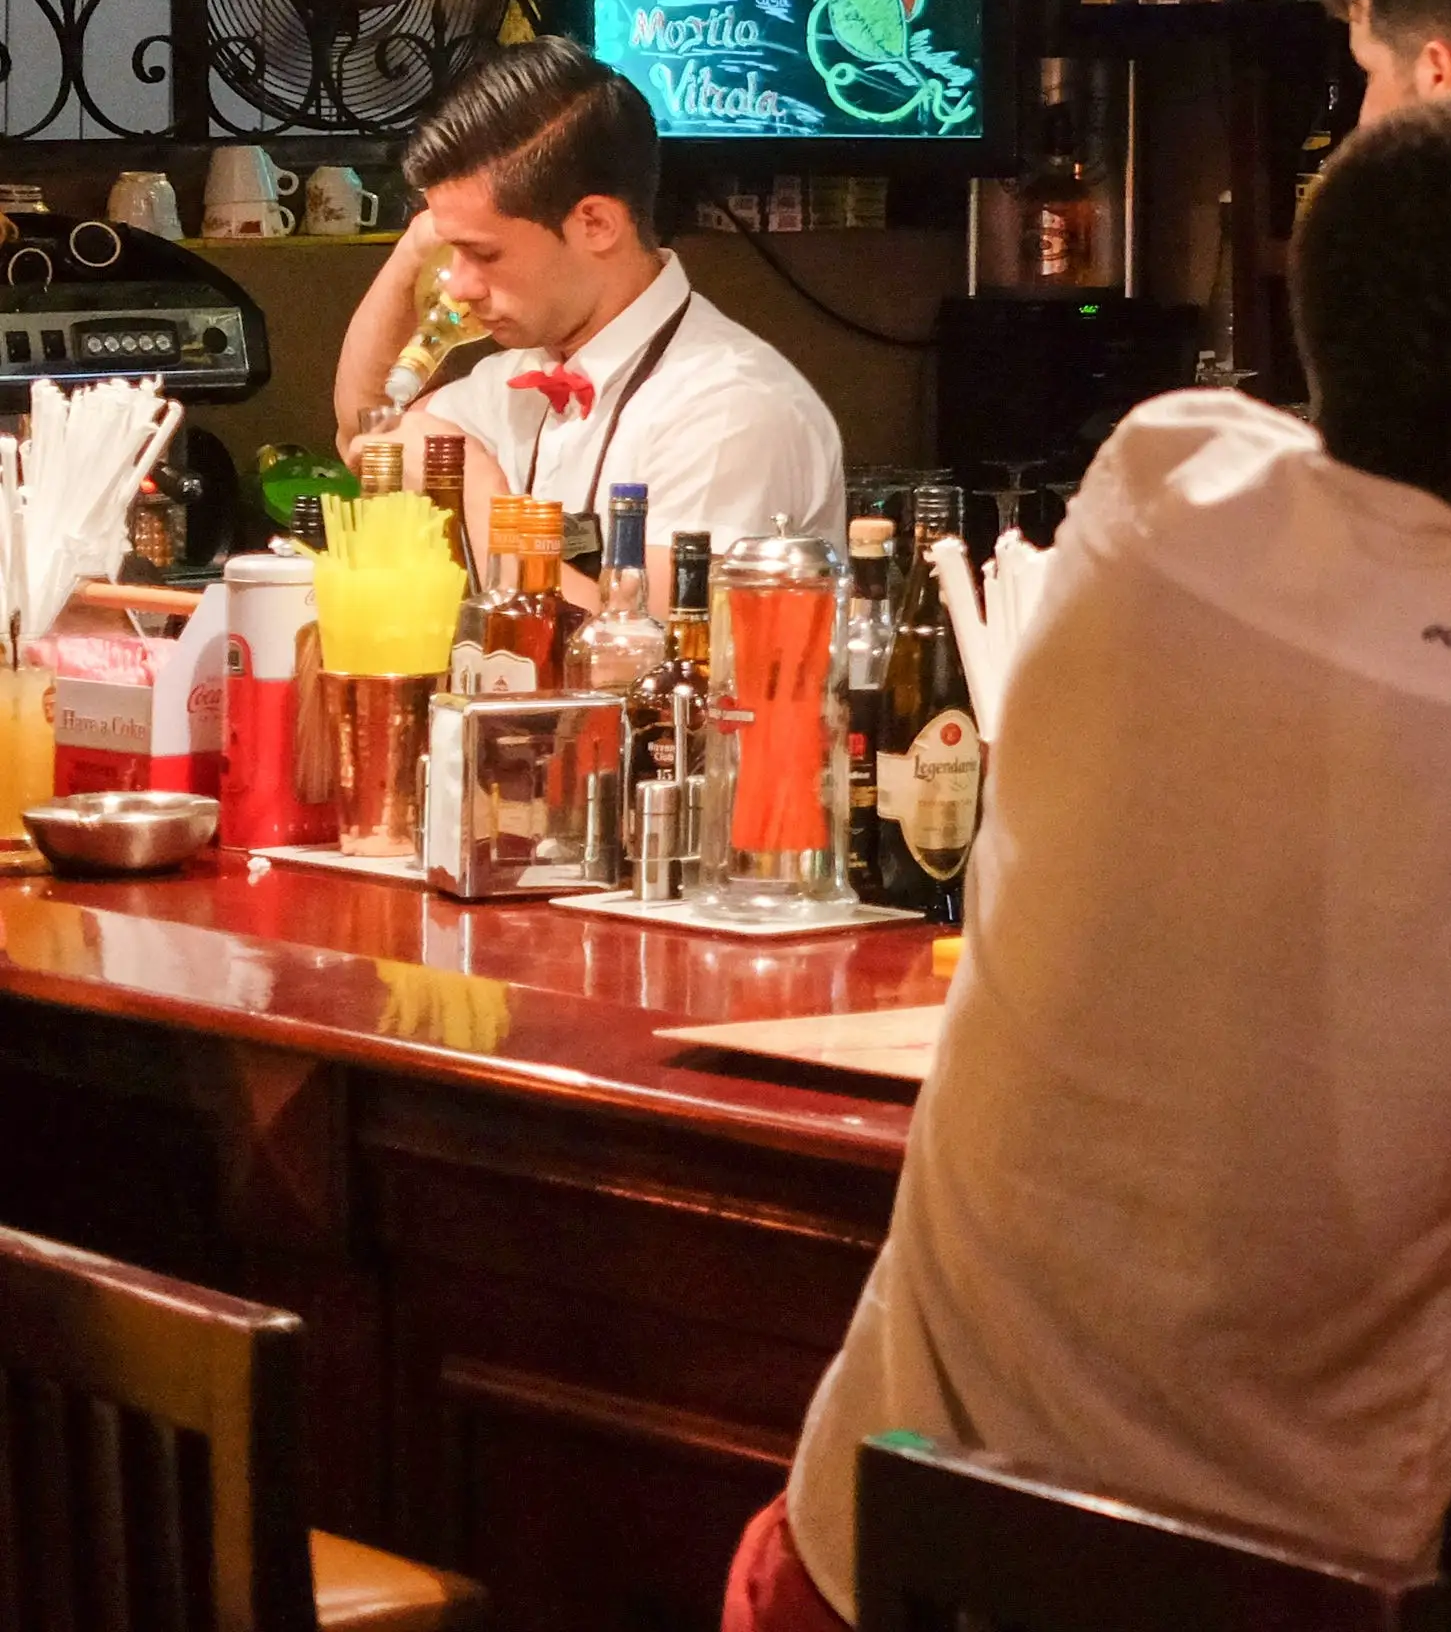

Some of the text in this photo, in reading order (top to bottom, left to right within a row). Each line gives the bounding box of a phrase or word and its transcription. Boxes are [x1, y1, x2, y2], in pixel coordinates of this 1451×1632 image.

[648, 58, 788, 122] Vitrola
[112, 717, 145, 739] Coke
[656, 769, 673, 780] 15
